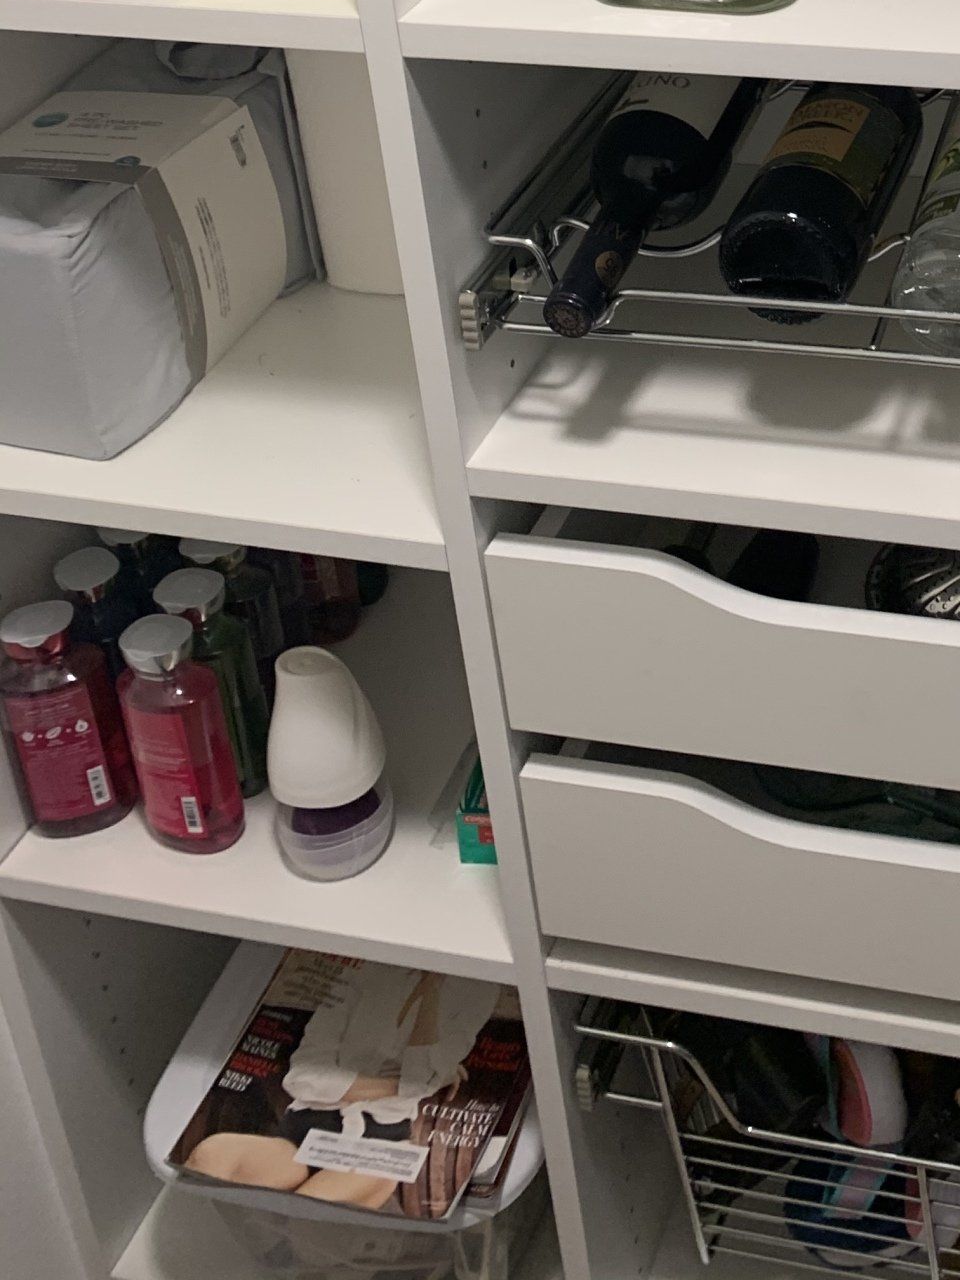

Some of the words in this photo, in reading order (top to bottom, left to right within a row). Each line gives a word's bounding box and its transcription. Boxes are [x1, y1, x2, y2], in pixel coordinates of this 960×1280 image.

[422, 1104, 493, 1125] CULTIVATE
[450, 1121, 491, 1136] CALM
[427, 1131, 480, 1148] ENERGY
